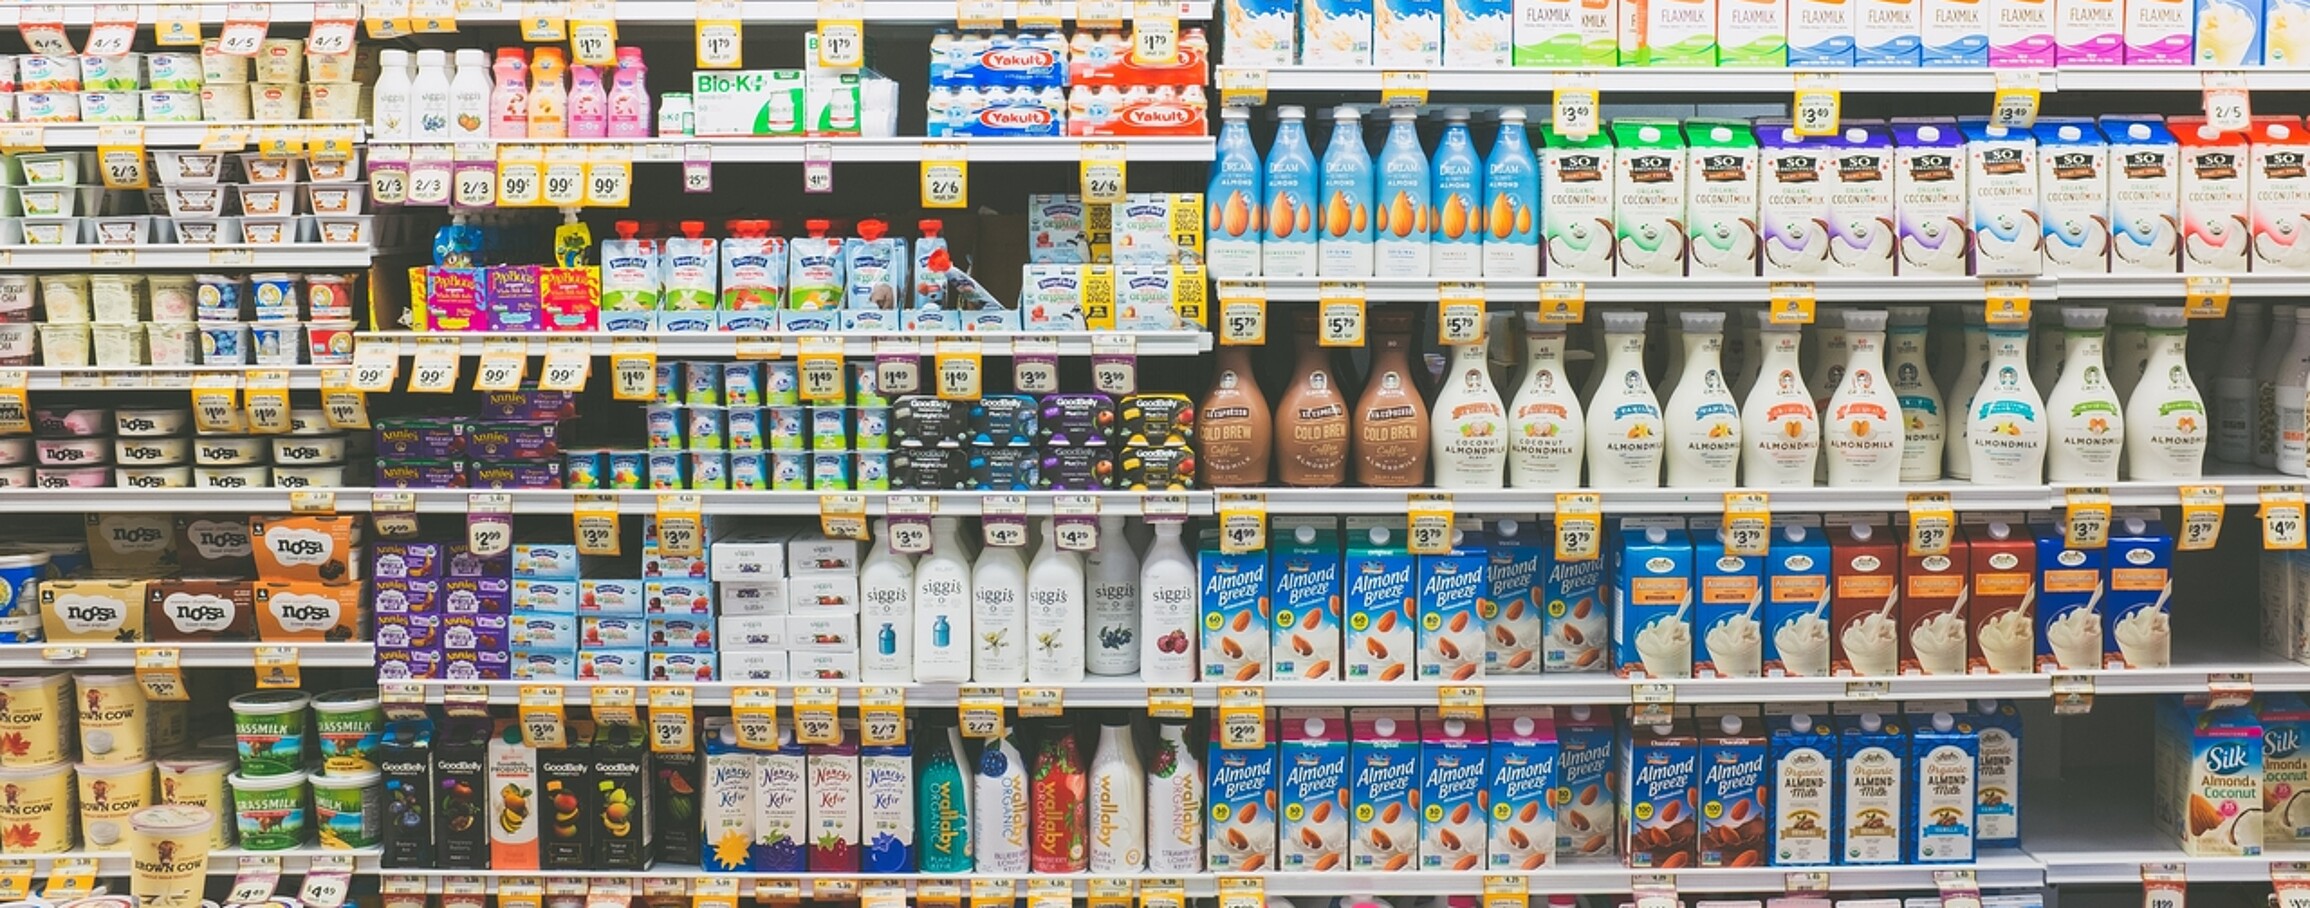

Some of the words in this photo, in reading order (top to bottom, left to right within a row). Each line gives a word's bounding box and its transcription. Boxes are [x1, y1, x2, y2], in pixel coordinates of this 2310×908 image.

[1526, 8, 1570, 22] FLAXMILK
[1661, 9, 1705, 23] FLAXMILK
[1732, 10, 1775, 23] FLAXMILK
[1802, 10, 1845, 24] FLAXMILK
[1868, 10, 1911, 24] FLAXMILK
[94, 37, 120, 48] 4/5
[227, 36, 253, 47] 4/5
[315, 35, 342, 47] 4/5
[992, 54, 1042, 66] Yakult
[990, 112, 1041, 124] Yakult
[1134, 111, 1183, 123] Yakult
[2216, 106, 2241, 118] 2/5
[1568, 156, 1591, 167] SO
[1641, 156, 1663, 166] SO
[1713, 156, 1735, 166] SO
[1786, 156, 1808, 166] SO
[1850, 156, 1872, 166] SO
[111, 164, 138, 179] 2/3
[377, 179, 402, 192] 2/3
[415, 179, 441, 191] 2/3
[463, 181, 489, 194] 2/3
[932, 181, 958, 193] 2/6
[1091, 180, 1117, 192] 2/6
[1552, 194, 1608, 205] COCONUTMILK
[1623, 195, 1679, 206] COCONUTMILK
[1696, 194, 1751, 205] COCONUTMILK
[1769, 195, 1825, 206] COCONUTMILK
[1832, 195, 1888, 205] COCONUTMILK
[911, 400, 951, 409] GoodBelly
[1223, 426, 1251, 439] BREW
[1296, 426, 1318, 440] COLD
[1319, 425, 1346, 439] BREW
[1364, 426, 1388, 441] COLD
[1390, 426, 1418, 440] BREW
[1831, 440, 1894, 449] ALMONDMILK
[1975, 439, 2038, 448] ALMONDMILK
[113, 528, 162, 543] noosa
[201, 531, 248, 548] noosa
[278, 538, 323, 556] noosa
[1206, 565, 1264, 596] Almond
[1277, 562, 1336, 593] Almond
[1352, 564, 1410, 596] Almond
[1424, 565, 1482, 596] Almond
[1492, 573, 1532, 596] Breeze
[1561, 573, 1600, 595] Breeze
[1218, 582, 1258, 608] Breeze
[1289, 582, 1329, 606] Breeze
[1364, 584, 1405, 608] Breeze
[1437, 583, 1476, 608] Breeze
[68, 606, 117, 620] noosa
[177, 606, 225, 621] noosa
[282, 606, 331, 620] noosa
[1279, 614, 1292, 622] 60
[1209, 616, 1221, 625] 60
[14, 712, 42, 723] COW
[2265, 726, 2300, 753] Silk
[438, 760, 483, 772] GoodBelly
[2206, 746, 2248, 772] Silk
[382, 761, 426, 774] GoodBelly
[543, 762, 588, 774] GoodBelly
[595, 762, 639, 774] GoodBelly
[1213, 759, 1271, 788] Almond
[1286, 757, 1344, 788] Almond
[1356, 755, 1415, 787] Almond
[1784, 767, 1824, 778] Organic
[1853, 766, 1894, 777] Organic
[1927, 764, 1967, 775] Organic
[1225, 776, 1265, 799] Breeze
[2201, 776, 2248, 788] Almond
[2250, 778, 2256, 787] &
[718, 791, 746, 808] Kefir
[768, 791, 792, 808] Kefir
[820, 791, 845, 808] Kefir
[2204, 786, 2256, 799] Coconut
[24, 802, 52, 814] COW
[112, 800, 139, 811] COW
[1002, 777, 1012, 838] ORGANIC
[1012, 774, 1028, 848] wallaby
[1092, 777, 1100, 837] ORGANIC
[1101, 774, 1119, 849] wallaby
[1173, 777, 1182, 838] ORGANIC
[931, 782, 940, 846] ORGANIC
[940, 780, 959, 855] wallaby
[1035, 782, 1045, 845] ORGANIC
[1045, 781, 1056, 855] wallaby
[135, 860, 173, 873] BROWN
[176, 859, 202, 873] COW
